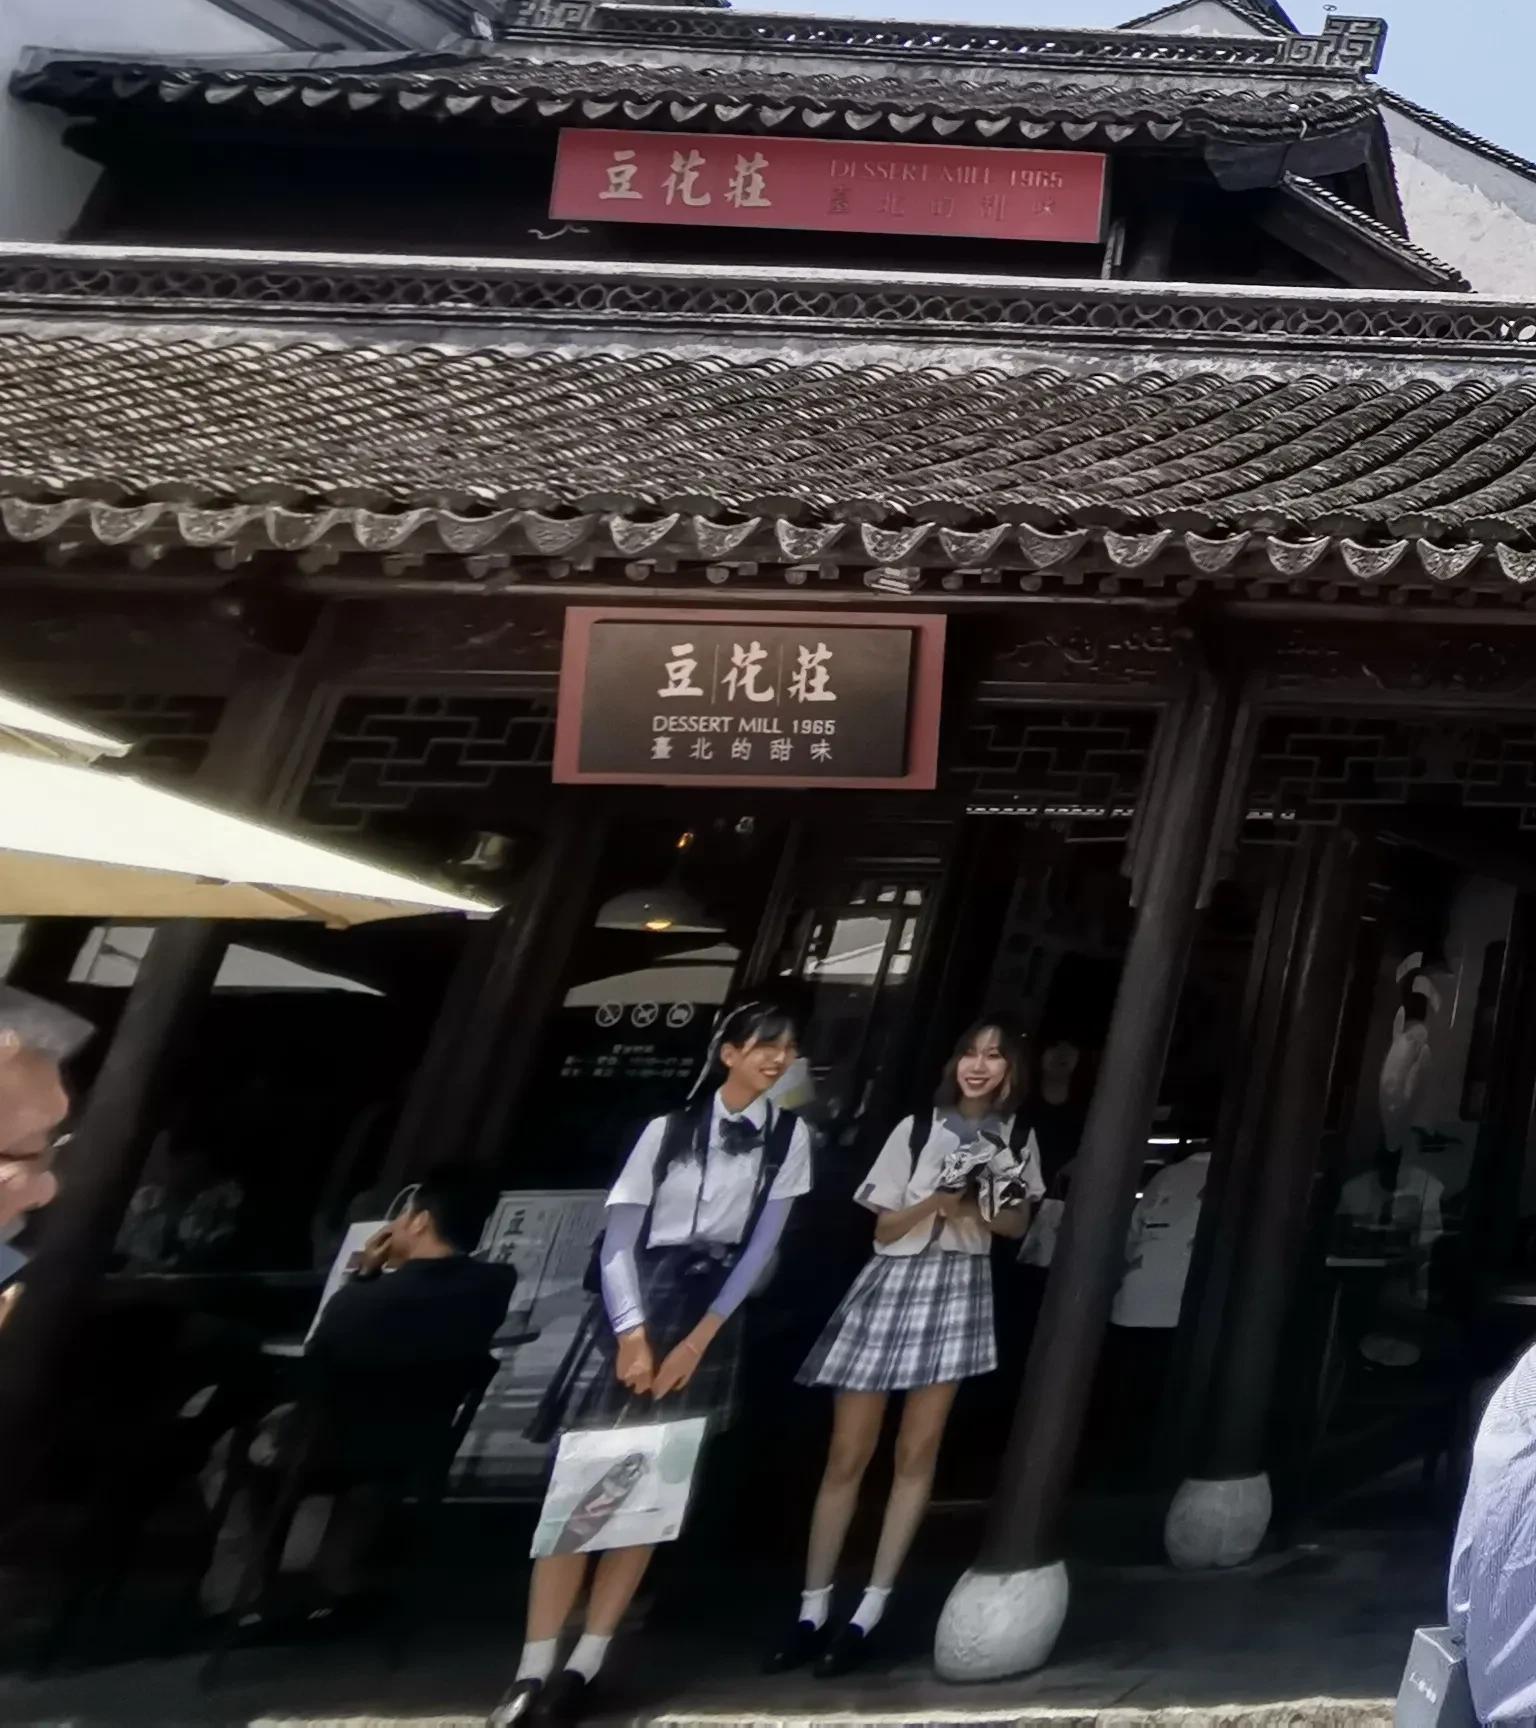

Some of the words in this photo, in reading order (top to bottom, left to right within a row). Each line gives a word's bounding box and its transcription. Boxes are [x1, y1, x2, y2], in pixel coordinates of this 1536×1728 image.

[1010, 169, 1064, 189] 1965
[652, 715, 734, 734] DESSERT
[738, 716, 783, 734] MILL
[792, 719, 836, 736] 1965
